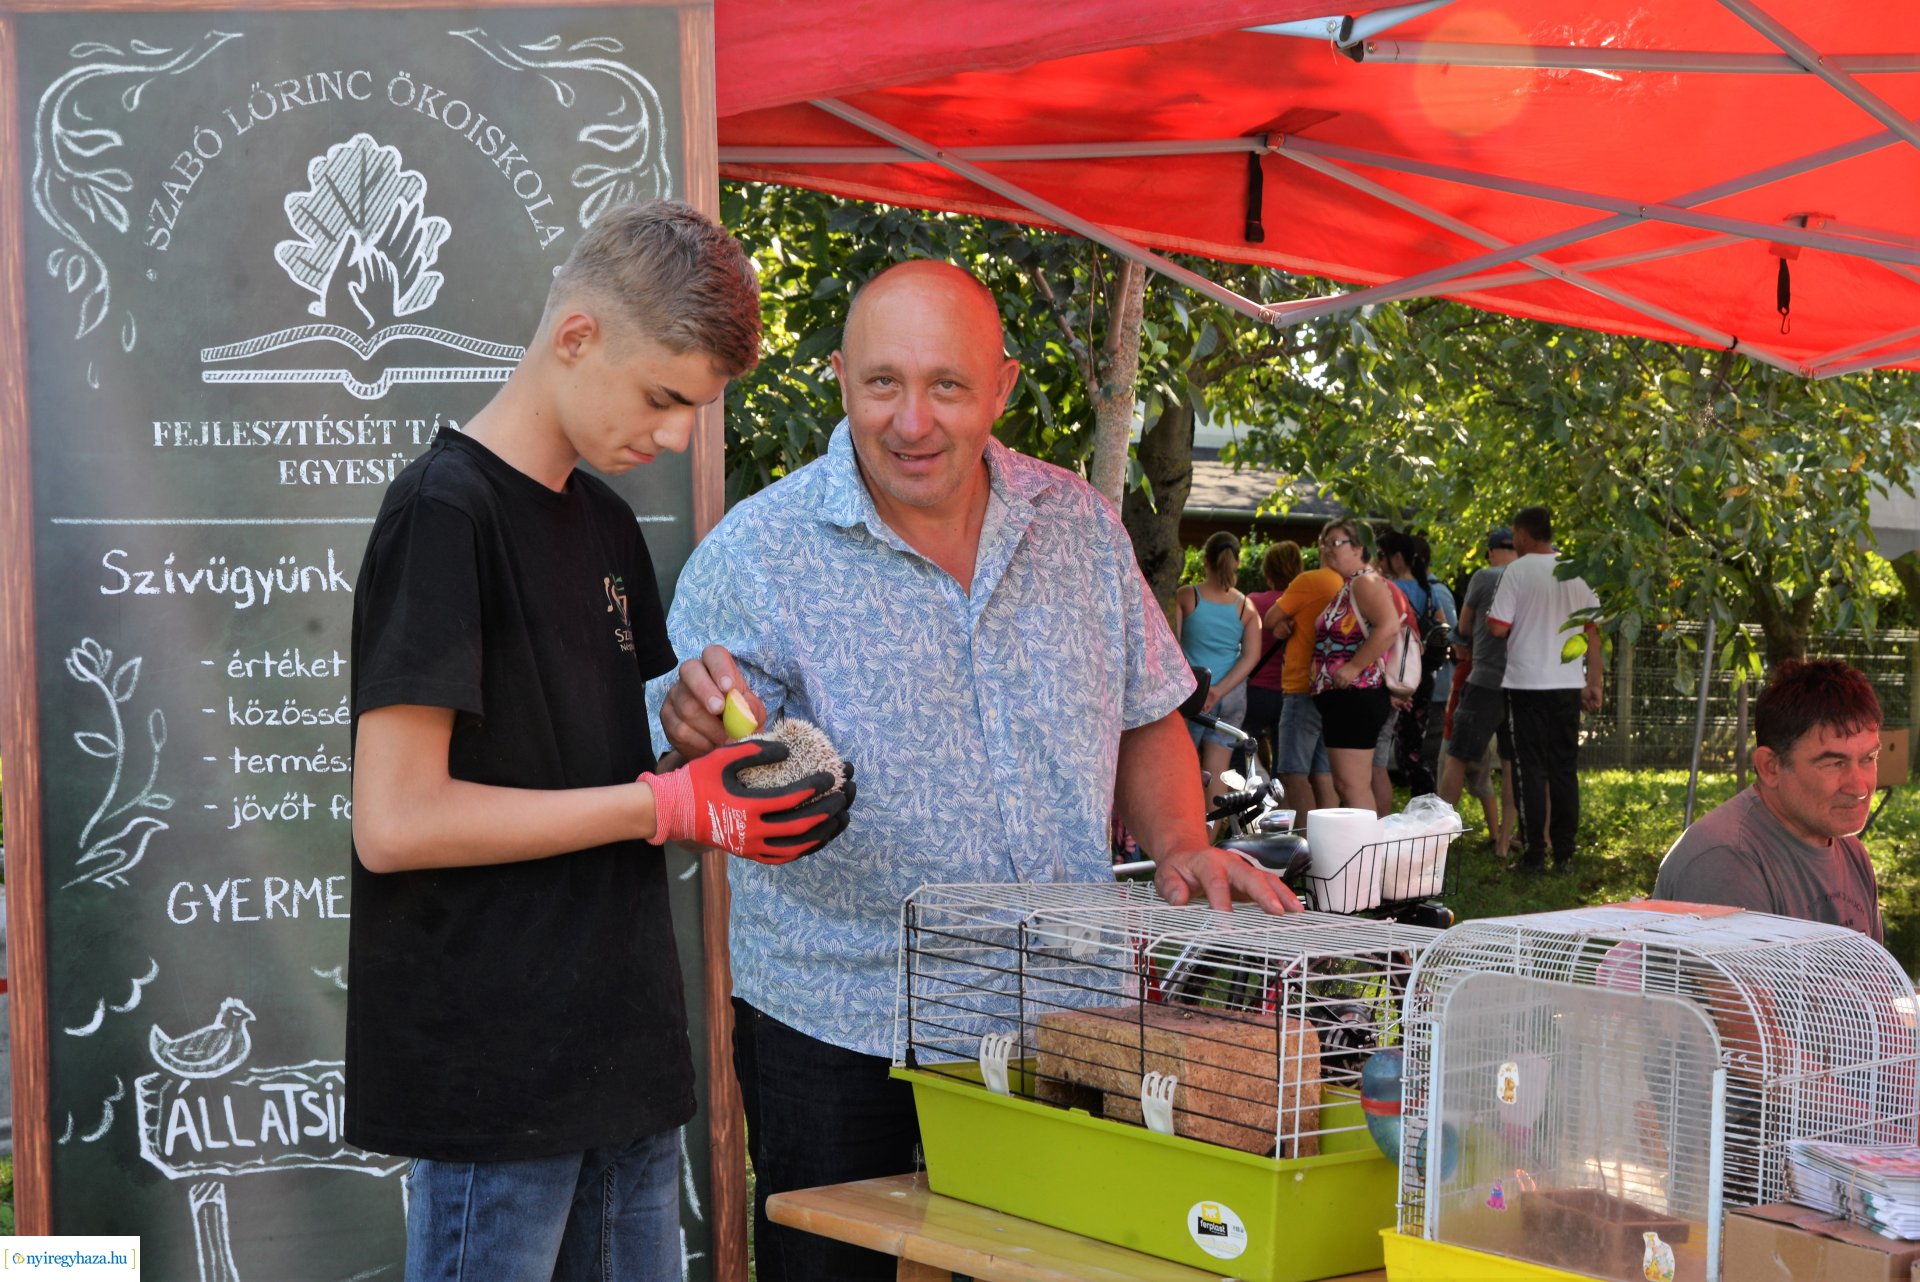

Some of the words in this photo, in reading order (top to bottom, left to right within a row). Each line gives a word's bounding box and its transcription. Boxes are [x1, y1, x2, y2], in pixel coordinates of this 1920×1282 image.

[144, 125, 223, 251] SZABÓ
[222, 70, 372, 136] LŐRINC
[387, 71, 565, 250] ÖKOISKOLA
[152, 413, 397, 447] FEJLESZTÉSÉT
[278, 452, 415, 485] EGYESÜ
[100, 548, 353, 609] Szívügyünk
[227, 648, 347, 678] értéket
[228, 695, 351, 726] közössé
[228, 743, 351, 774] termés
[227, 792, 316, 830] jövőt
[167, 875, 351, 924] GYERME
[1200, 1220, 1226, 1233] ferplast
